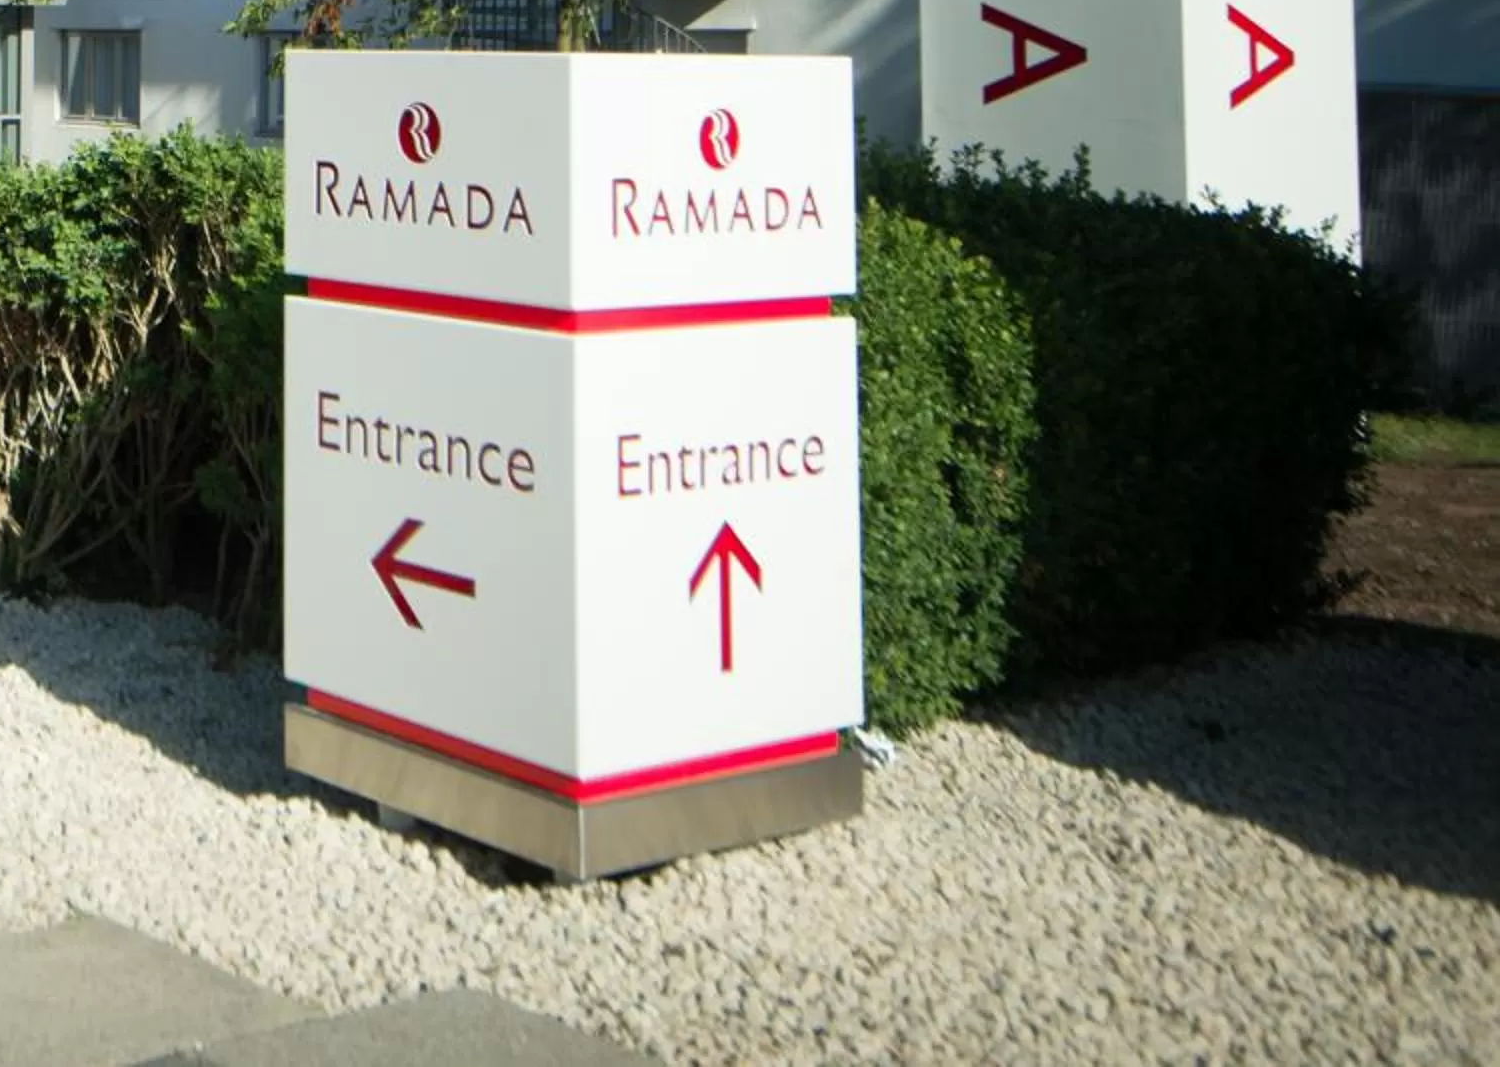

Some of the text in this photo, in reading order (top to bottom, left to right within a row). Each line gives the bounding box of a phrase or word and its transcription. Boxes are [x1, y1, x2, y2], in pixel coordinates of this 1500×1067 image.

[316, 161, 533, 236] RAMADA
[611, 178, 822, 238] RAMADA
[317, 391, 535, 493] Entrance
[617, 434, 825, 497] Entrance
